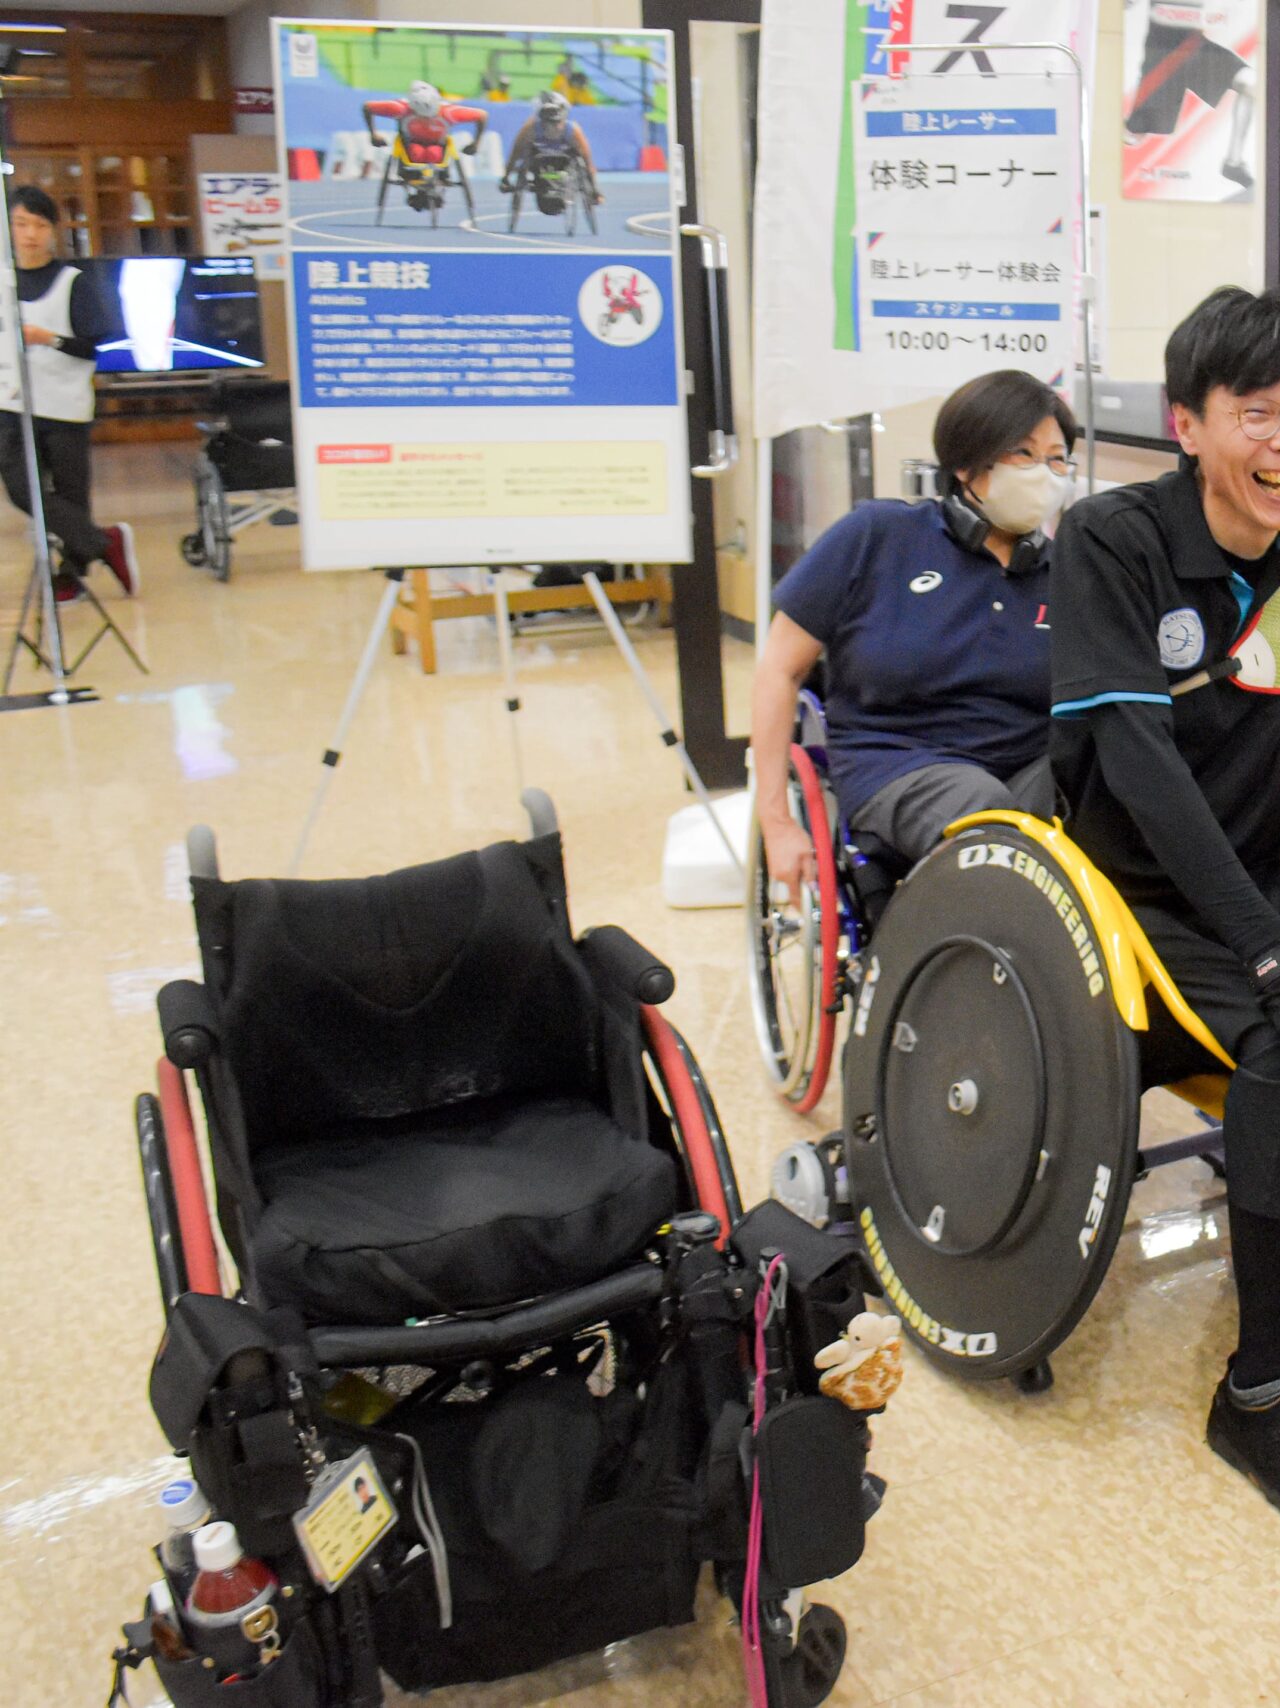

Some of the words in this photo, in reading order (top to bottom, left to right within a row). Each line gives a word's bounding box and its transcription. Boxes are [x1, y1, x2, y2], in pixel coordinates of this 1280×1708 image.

[902, 111, 1016, 132] 陸上レーサー
[870, 159, 1057, 191] 体験コーナー
[307, 260, 431, 290] 陸上競技
[870, 258, 1061, 283] 陸上レーサー体験会
[914, 302, 1015, 317] スケジュール
